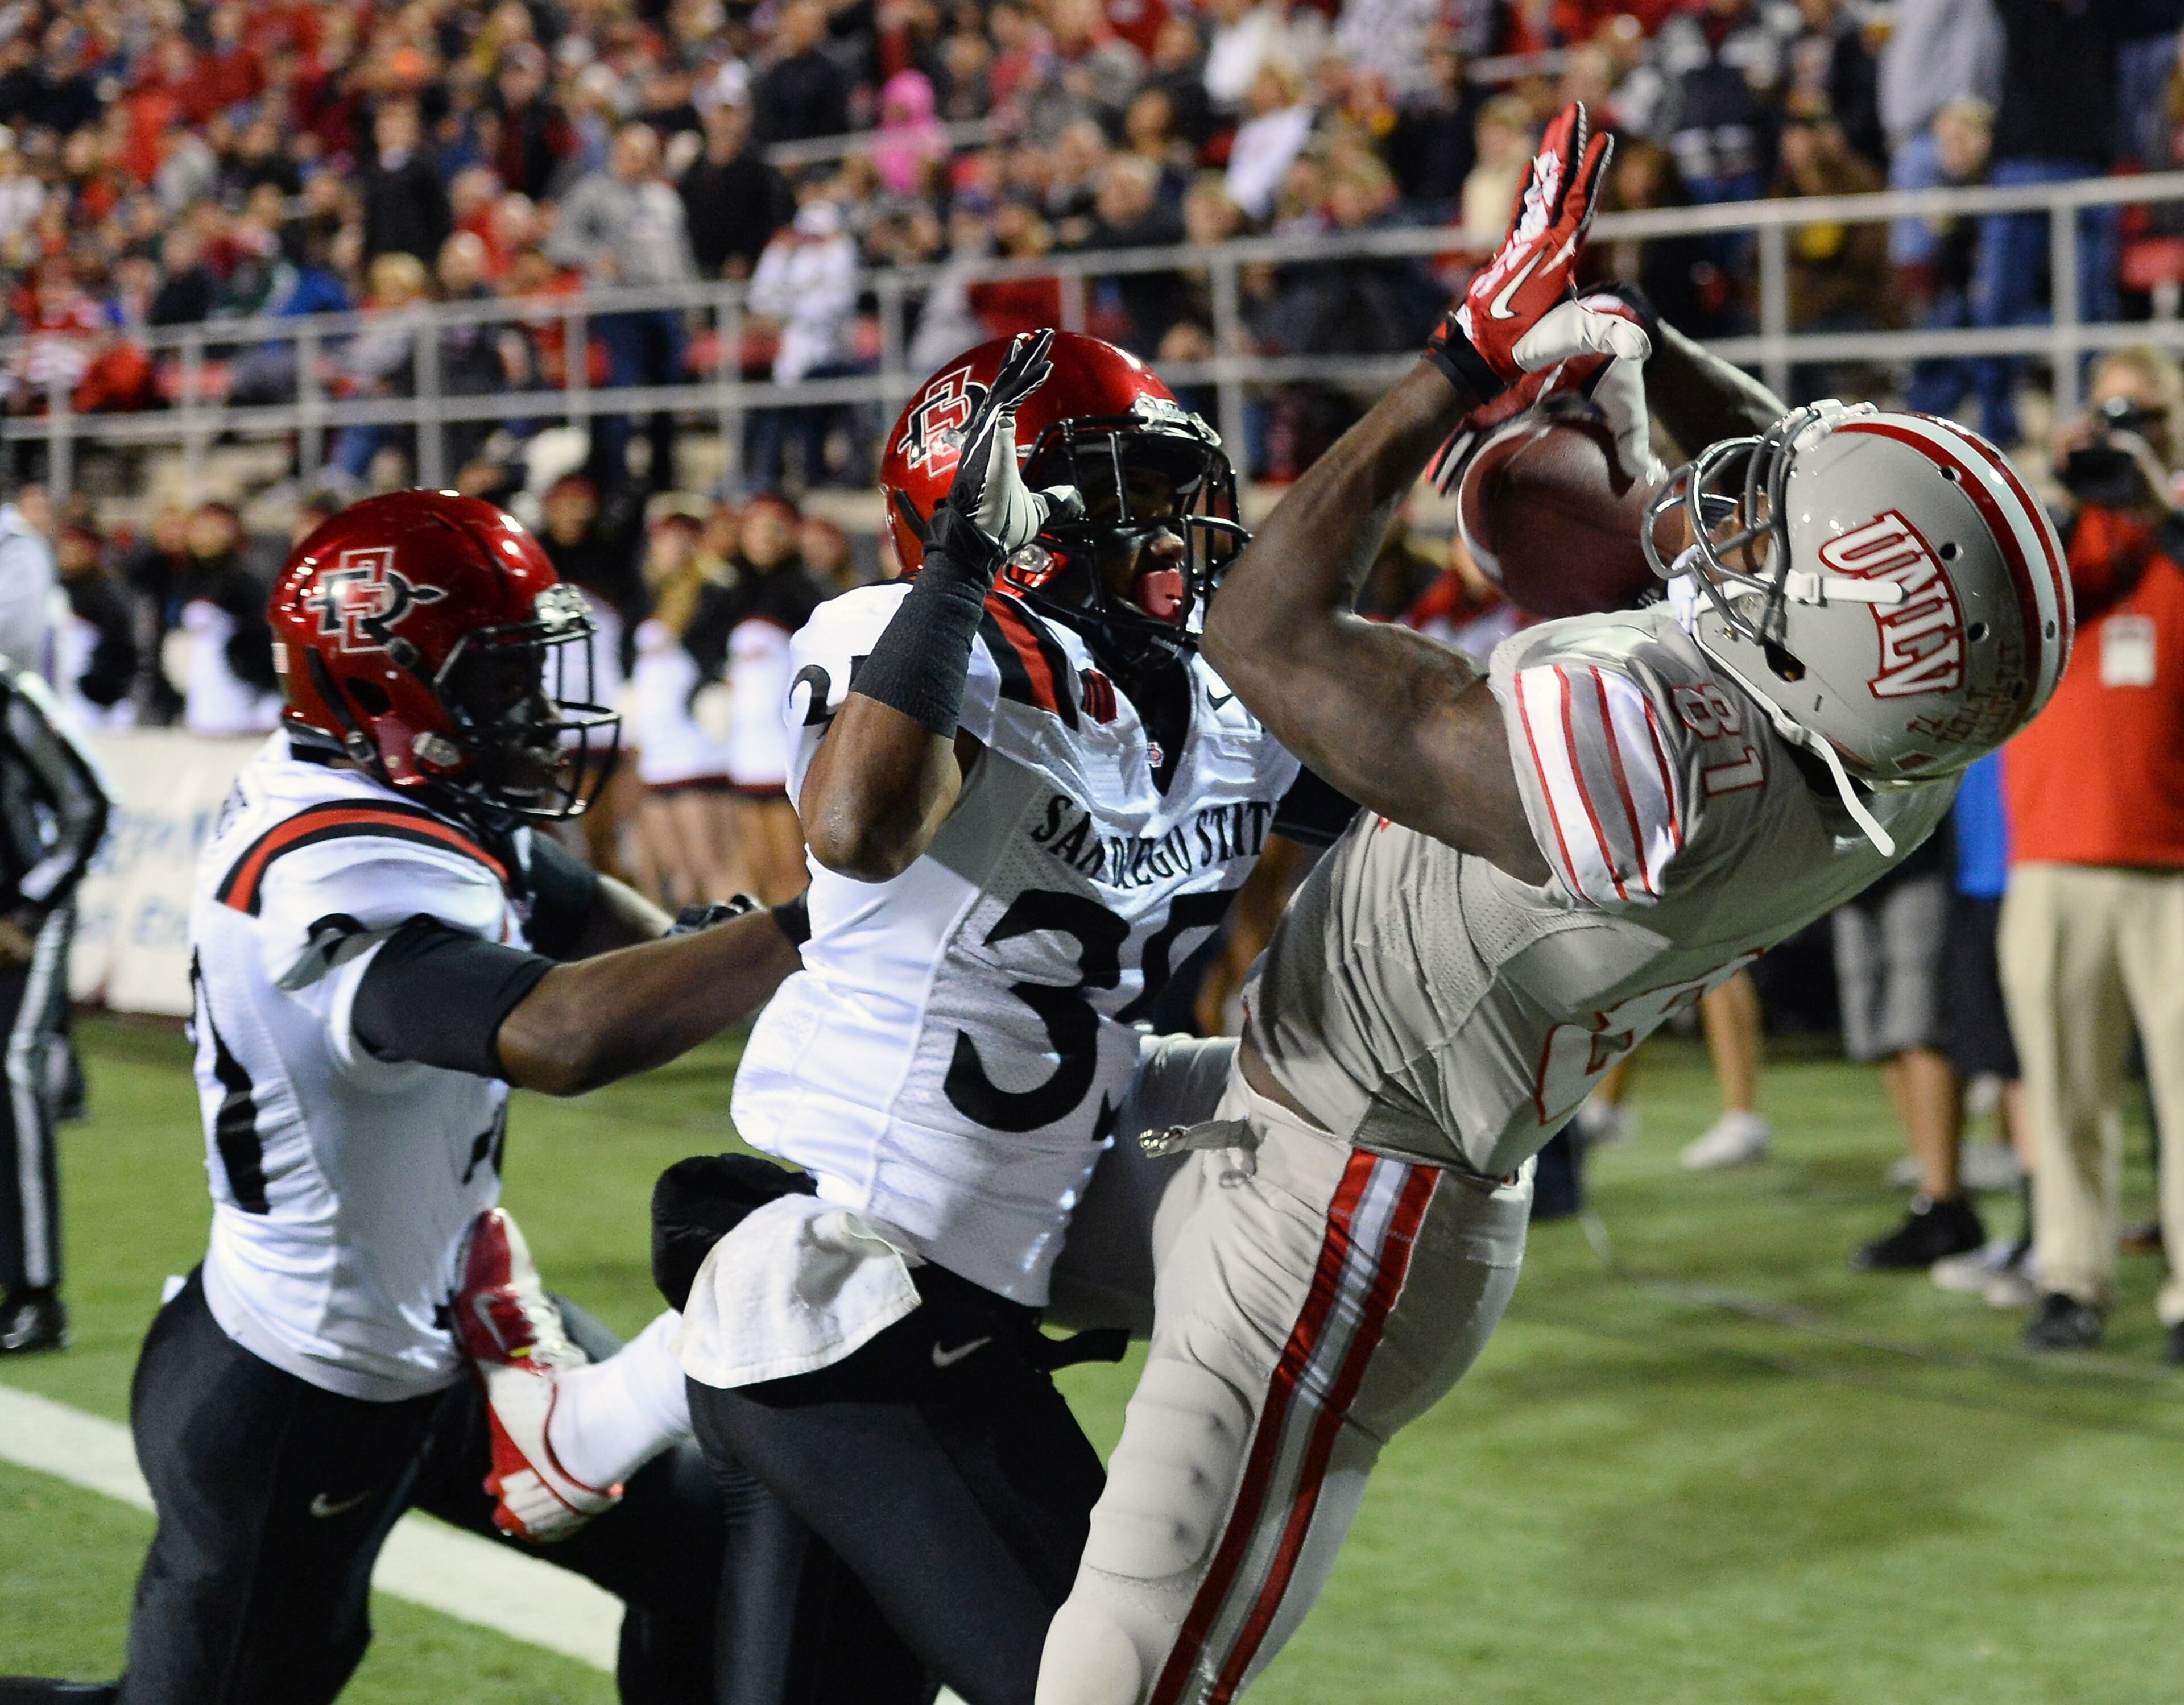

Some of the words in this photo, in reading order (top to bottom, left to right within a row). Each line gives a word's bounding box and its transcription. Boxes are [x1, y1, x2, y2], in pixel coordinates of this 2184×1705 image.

[1818, 508, 1966, 700] UNLV
[1670, 682, 1769, 798] 81
[1194, 800, 1273, 867] STAT
